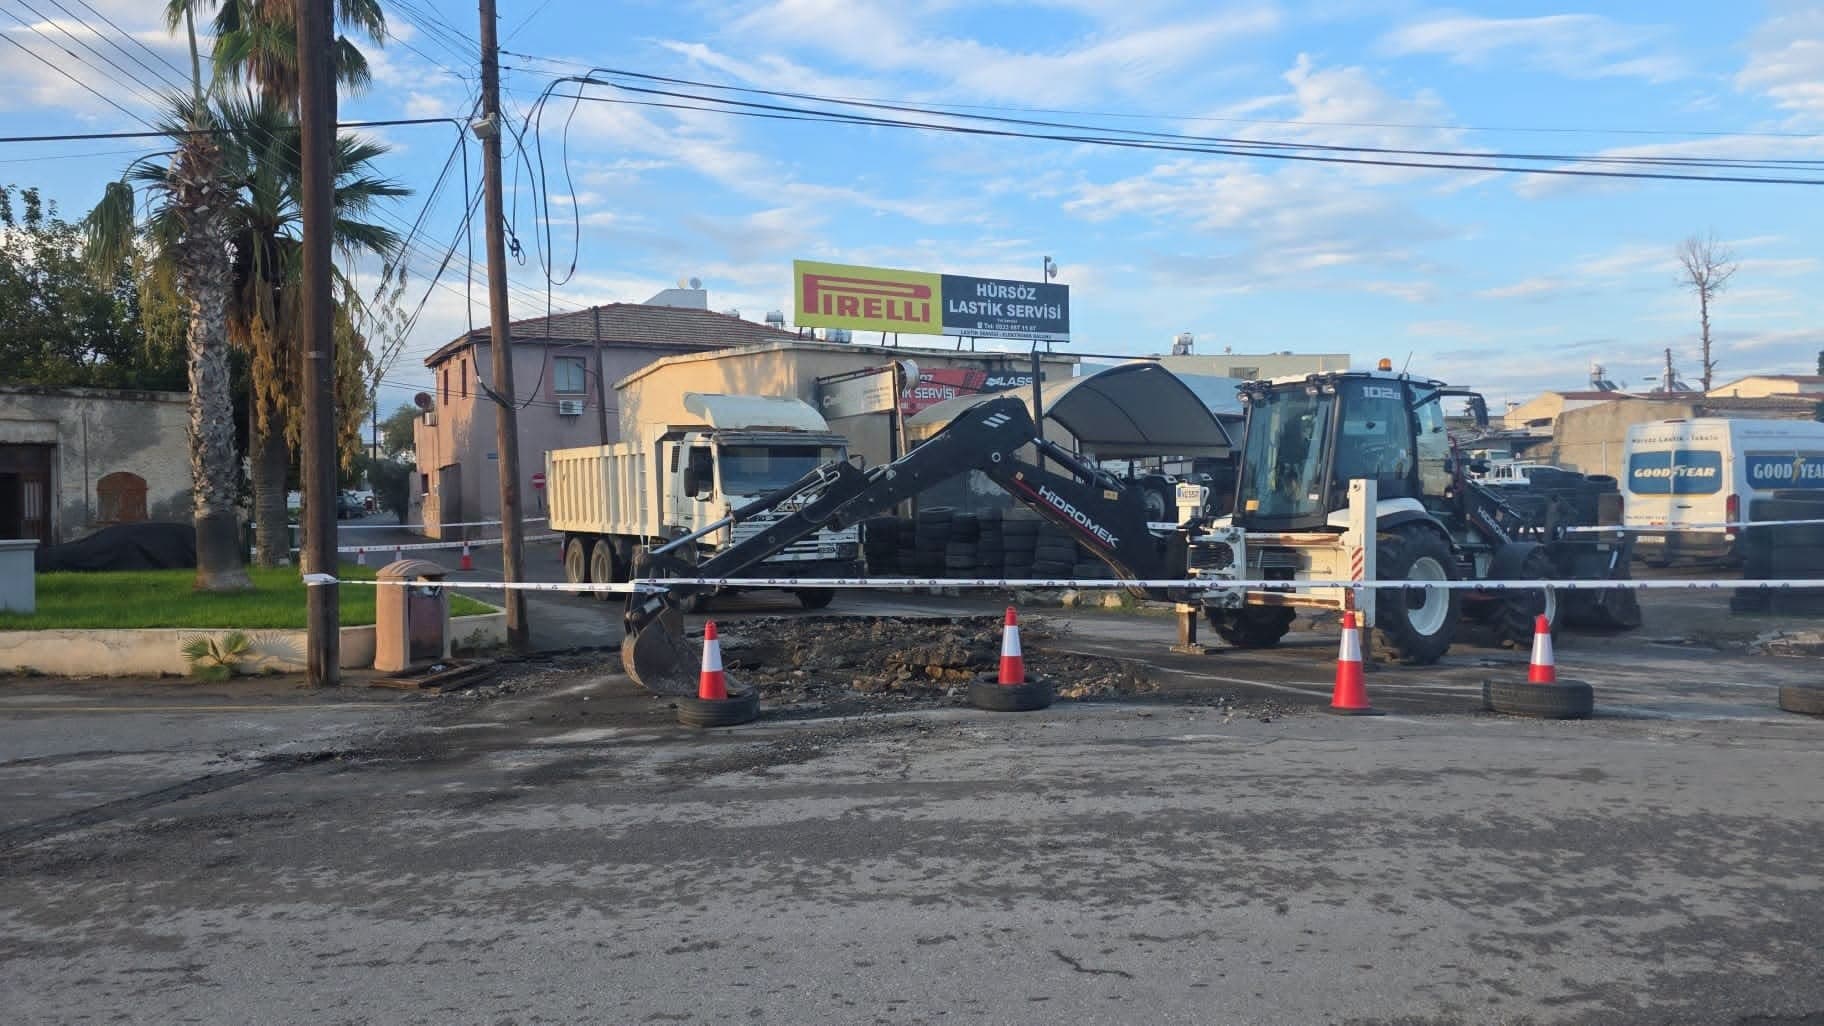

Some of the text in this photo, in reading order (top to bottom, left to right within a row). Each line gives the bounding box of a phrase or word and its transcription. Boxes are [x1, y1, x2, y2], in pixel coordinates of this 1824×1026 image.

[803, 274, 931, 322] PIRELLI
[976, 282, 1036, 300] HÜRSÖZ
[949, 299, 1061, 319] LASTİK SERVİSİ
